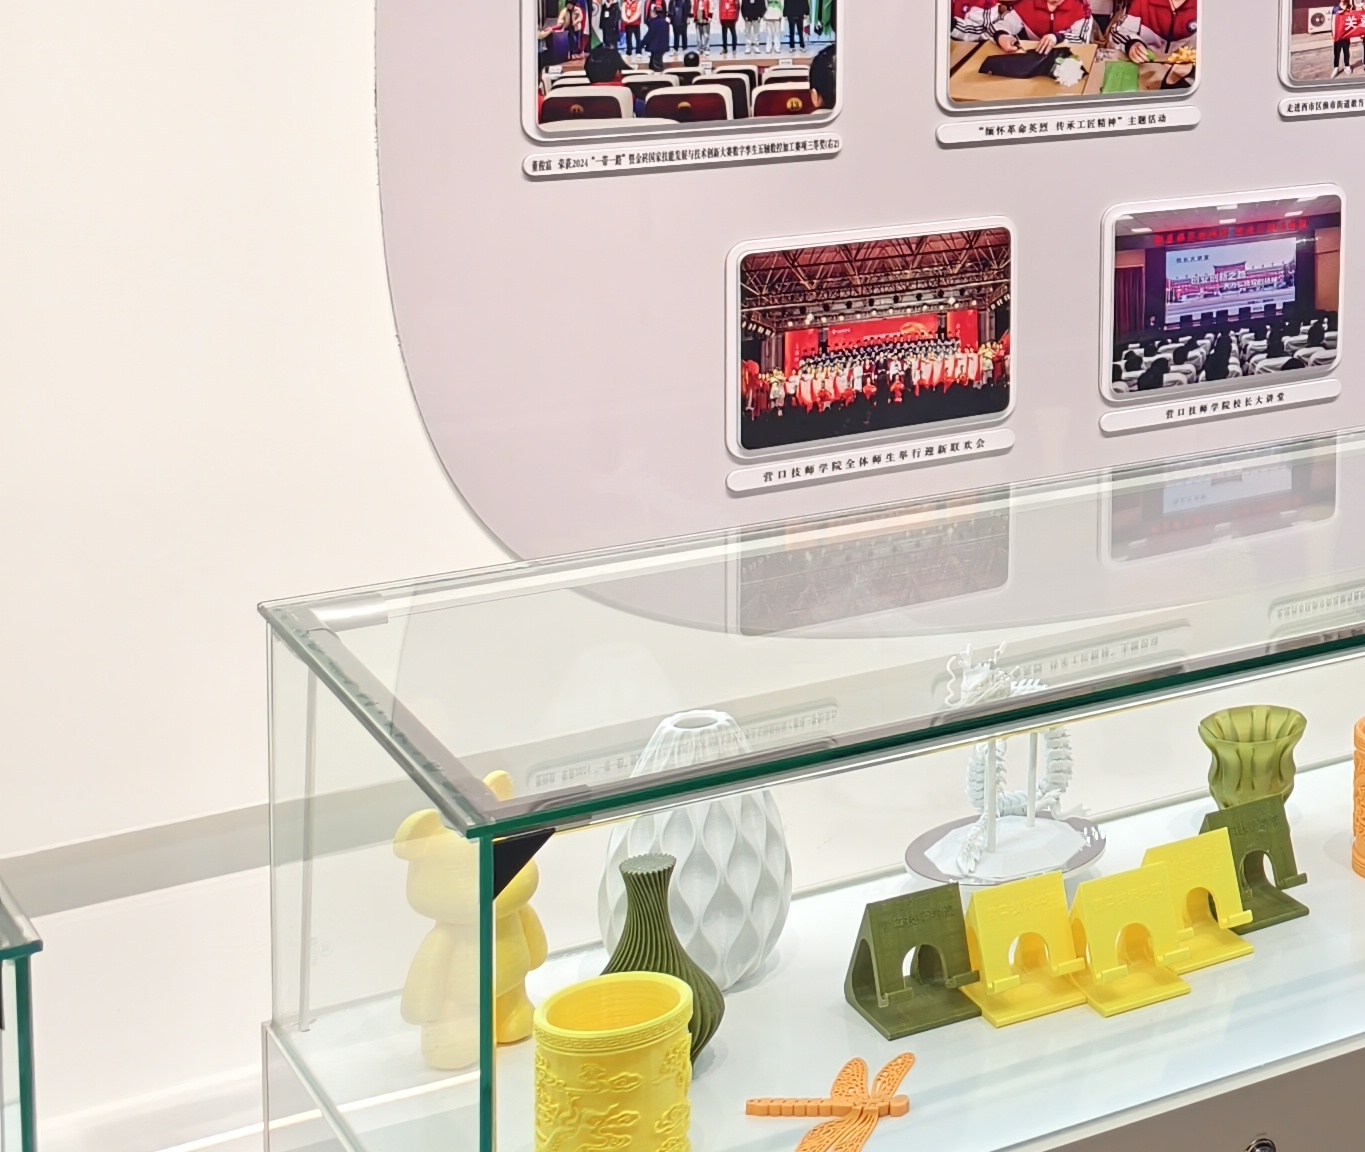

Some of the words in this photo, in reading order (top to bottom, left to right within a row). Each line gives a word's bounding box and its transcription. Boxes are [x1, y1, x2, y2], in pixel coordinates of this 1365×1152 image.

[1165, 391, 1286, 419] 营口技师学院校长大讲堂
[762, 437, 986, 483] 营口技师学院全体师生举行迎新联欢会
